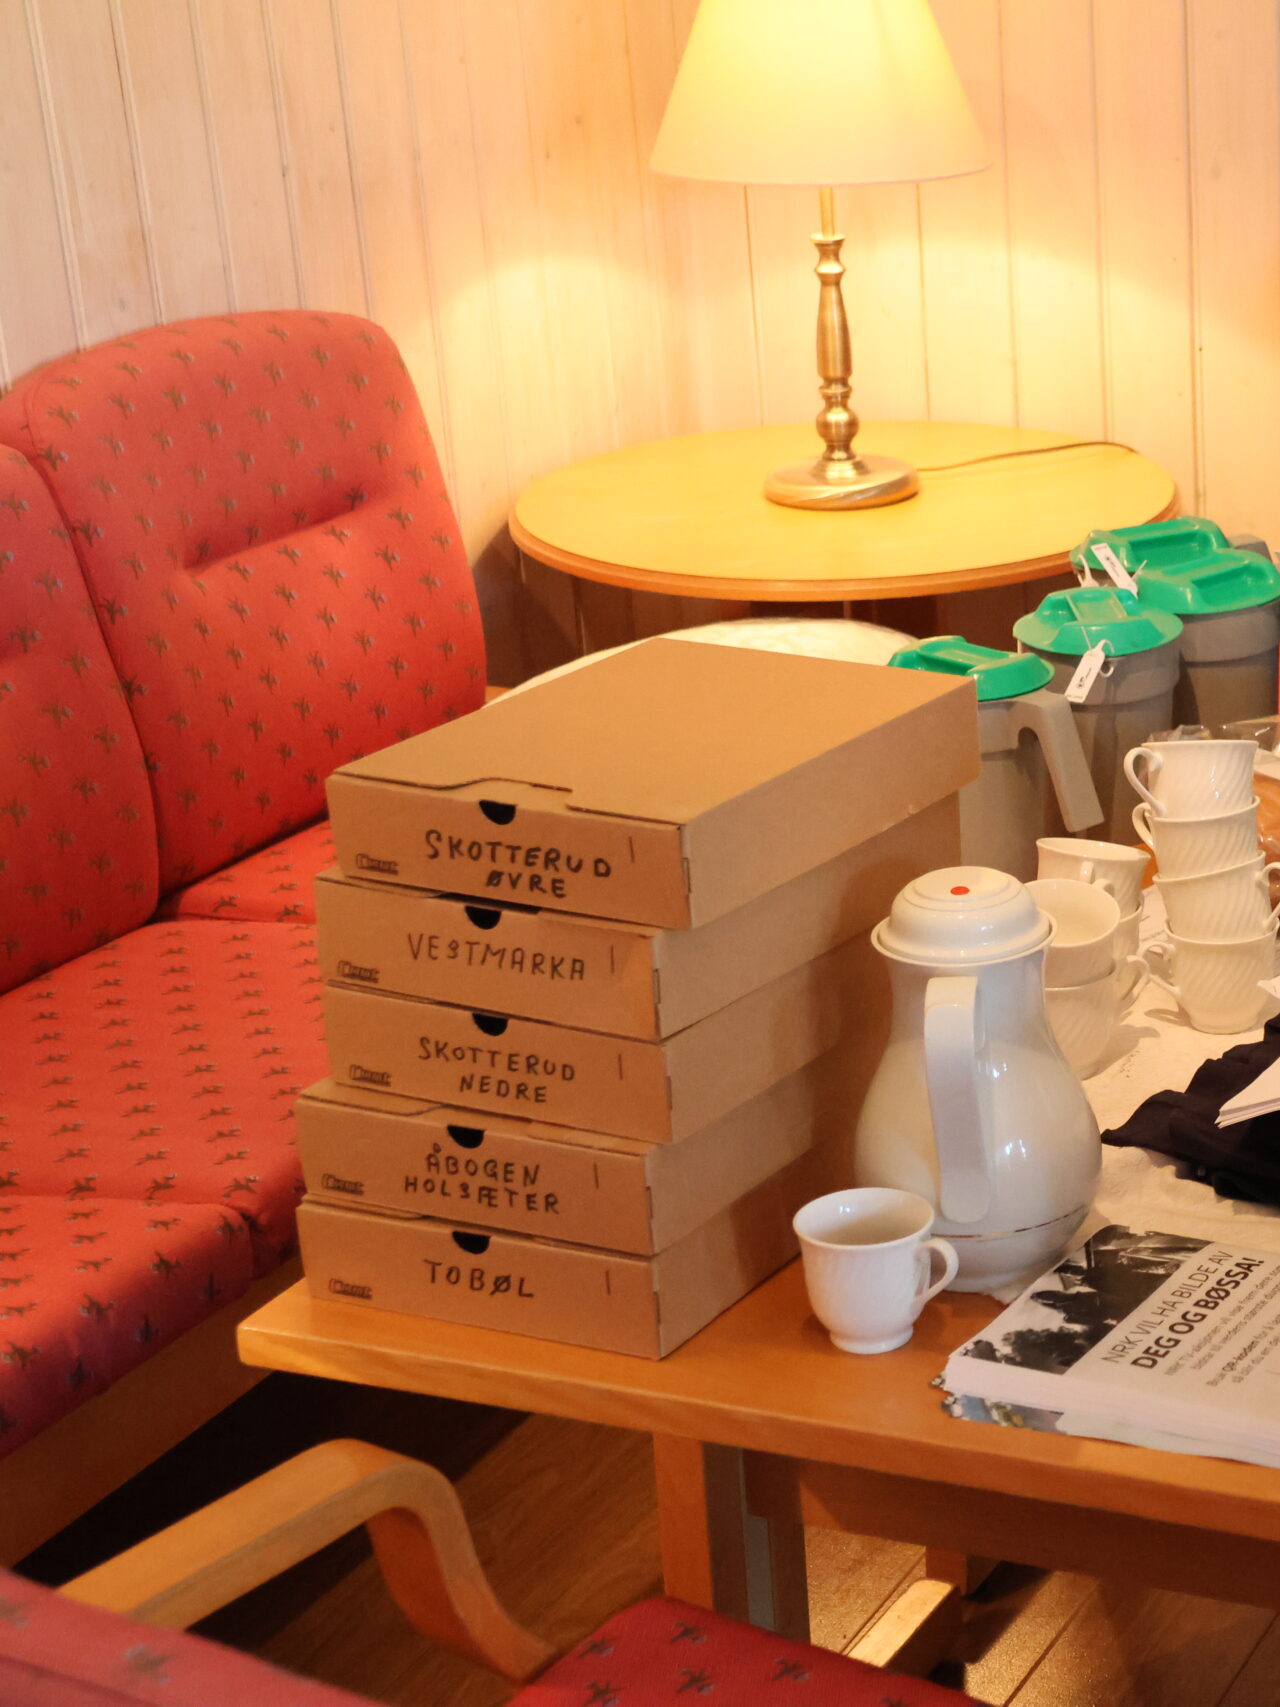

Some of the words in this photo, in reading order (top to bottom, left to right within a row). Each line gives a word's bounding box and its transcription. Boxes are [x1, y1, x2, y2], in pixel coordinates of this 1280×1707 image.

[426, 829, 611, 878] SKOTTERUD
[485, 870, 567, 898] ØVRE
[407, 933, 585, 981] VESTMARKA
[418, 1037, 575, 1082] SKOTTERUD
[460, 1073, 548, 1104] NEDRE
[427, 1143, 540, 1186] ÅBOGEN
[404, 1176, 559, 1215] HOLSÆTER
[423, 1260, 535, 1298] TOBØL
[1101, 1335, 1144, 1363] NRK
[1130, 1320, 1163, 1335] VIL
[1151, 1300, 1179, 1318] HA
[1171, 1264, 1218, 1299] BILDE
[1208, 1250, 1233, 1266] AV
[1130, 1336, 1181, 1369] DEG
[1168, 1310, 1208, 1335] OG
[1193, 1257, 1265, 1311] BØSSA!
